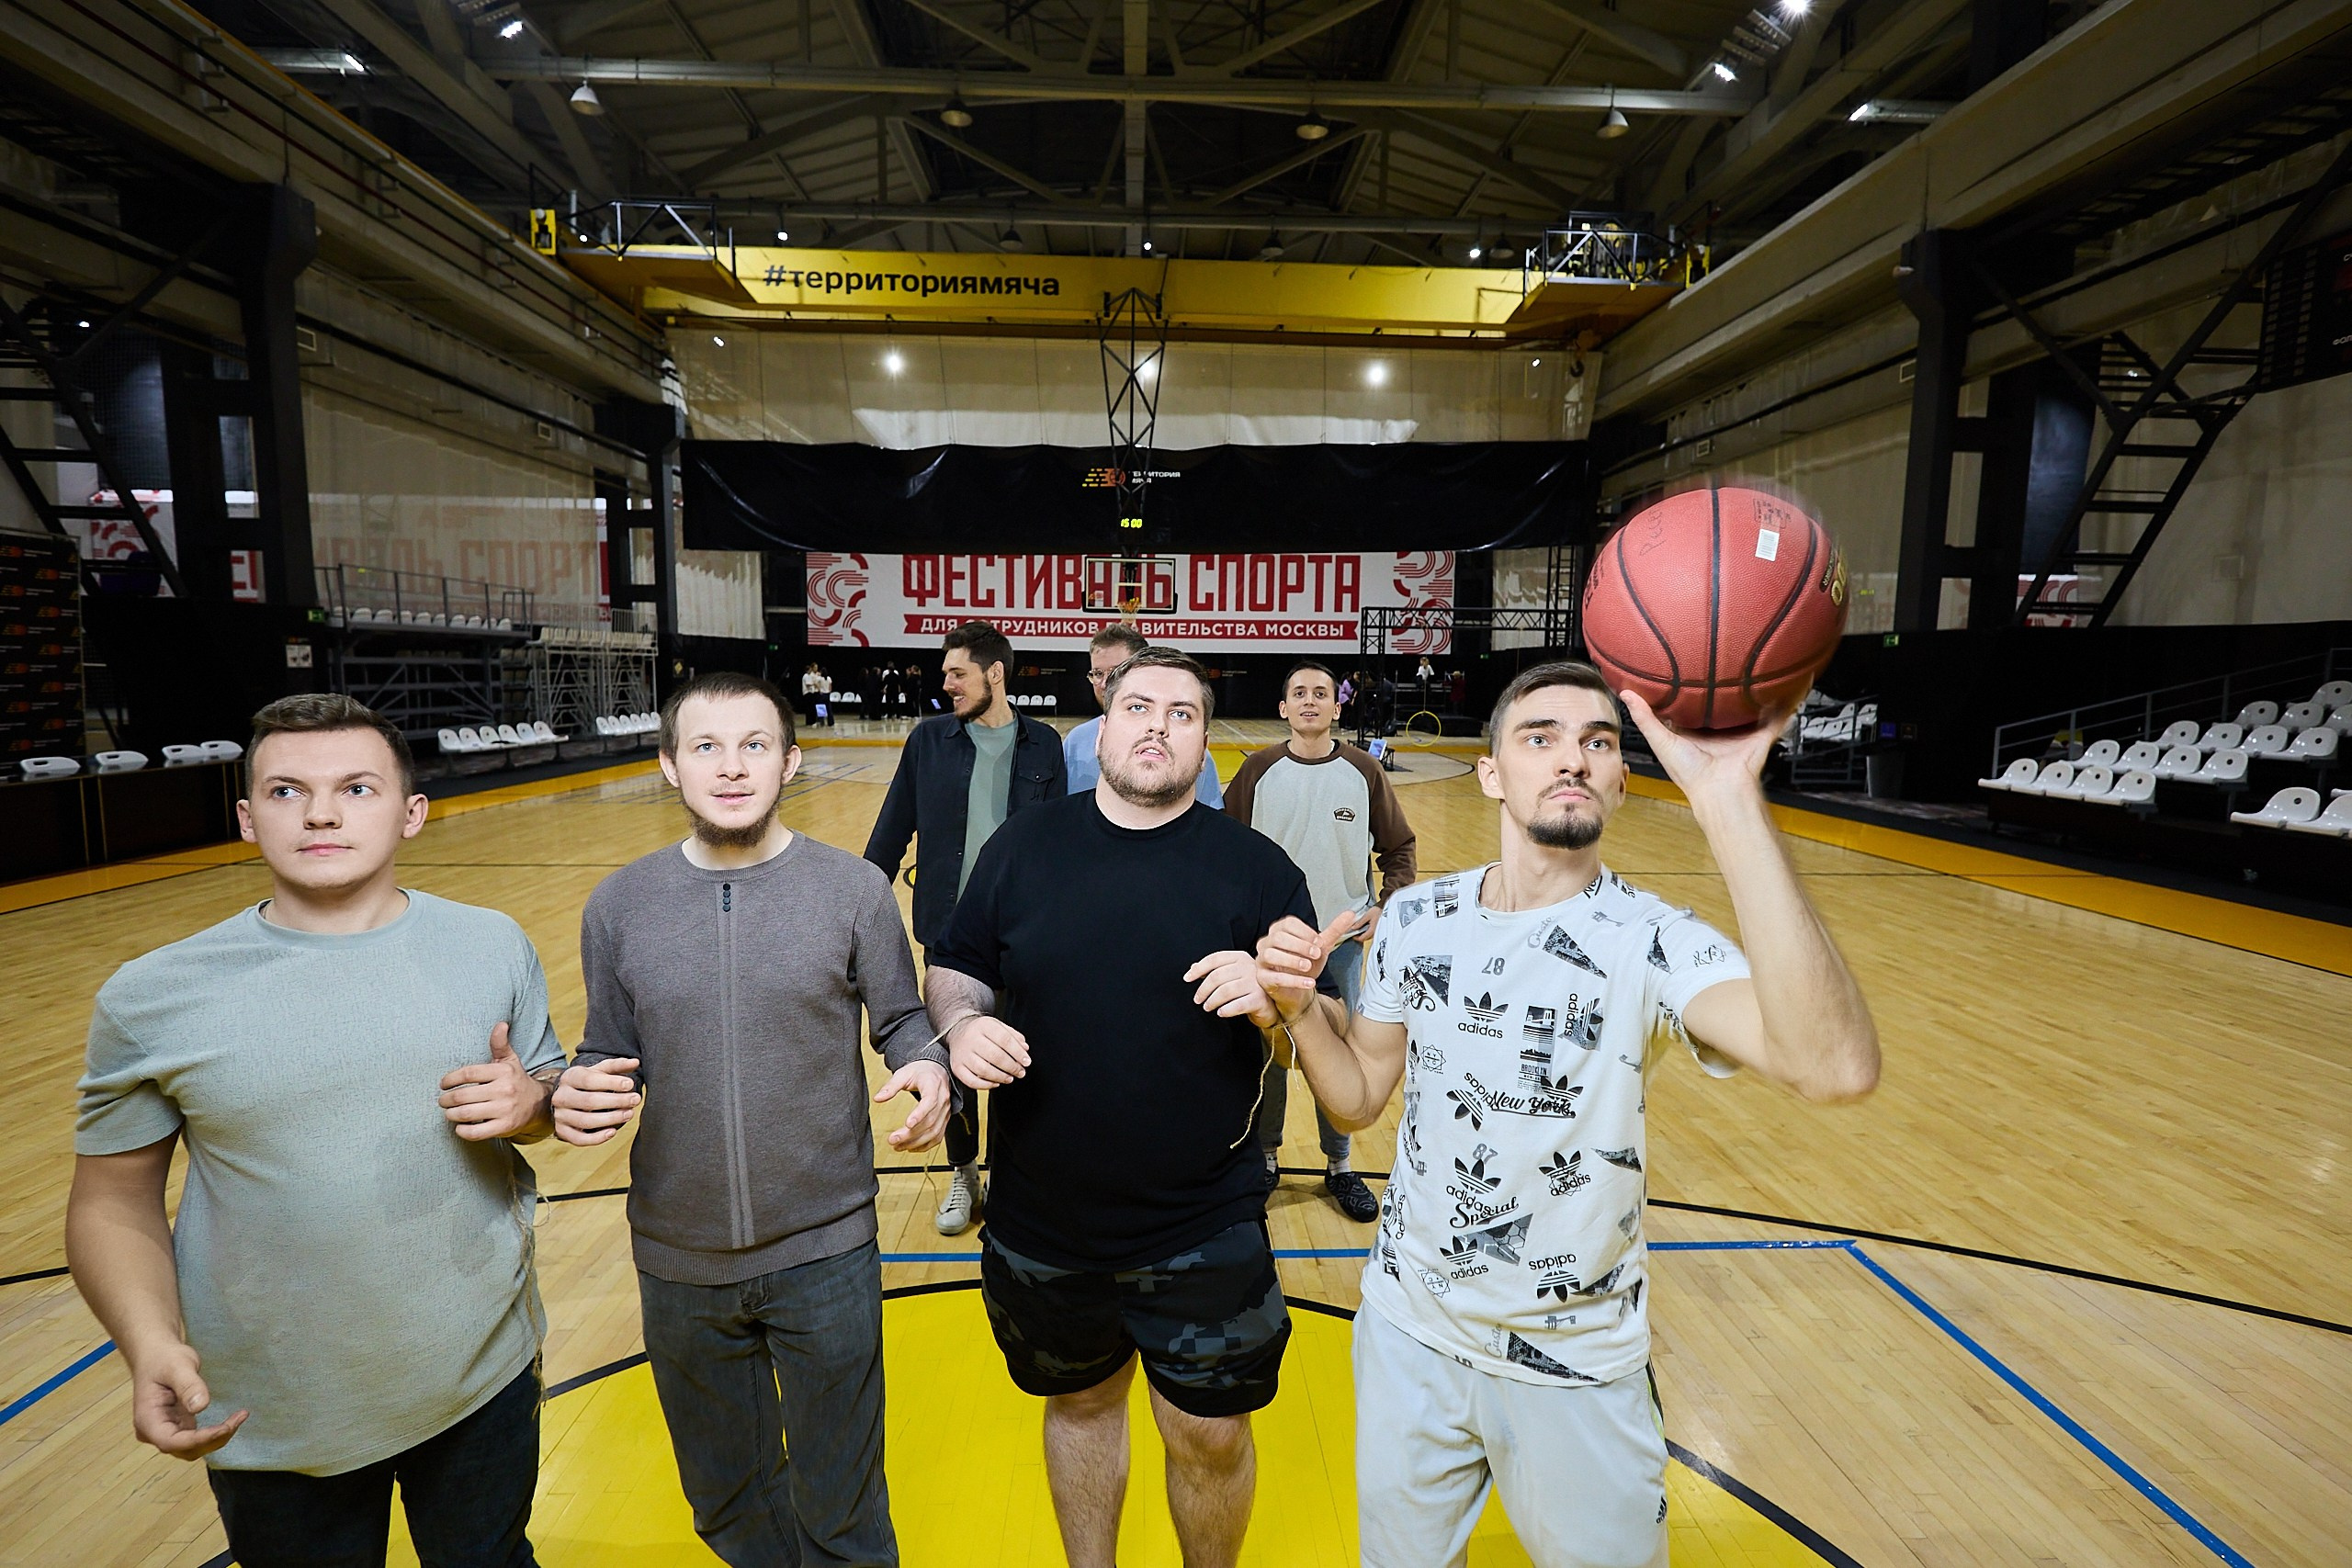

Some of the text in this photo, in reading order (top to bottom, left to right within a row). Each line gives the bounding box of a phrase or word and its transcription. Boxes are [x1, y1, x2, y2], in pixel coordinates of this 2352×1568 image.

[763, 265, 1060, 297] #территориямяча
[1189, 553, 1361, 613] СПОРТА
[921, 617, 1344, 637] ДЛЯ ТРУДНИКОВ АВИТЕЛЬСТВА МОСКВЫ
[1564, 993, 1578, 1037] adidas
[1457, 1021, 1503, 1039] adidas
[1446, 1185, 1492, 1216] adidas
[1451, 1264, 1489, 1280] adidas
[1529, 1253, 1577, 1270] adidas
